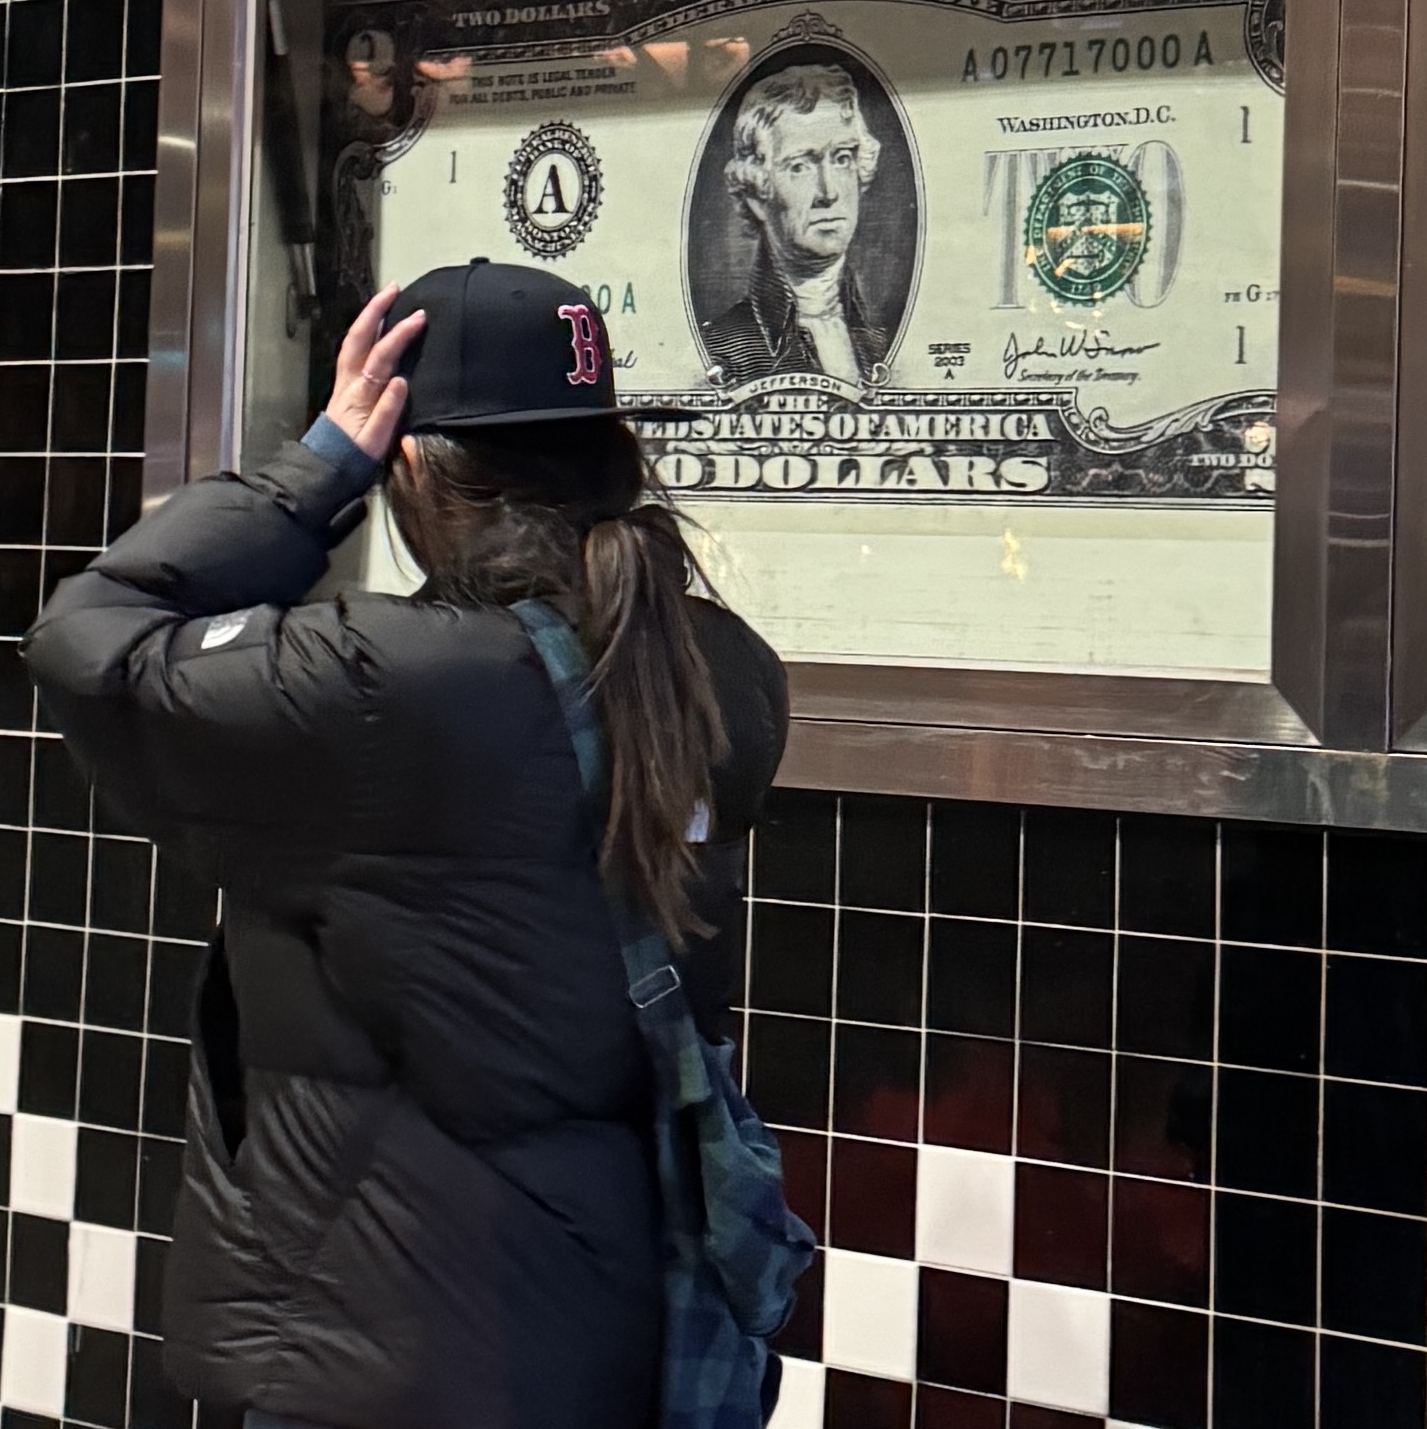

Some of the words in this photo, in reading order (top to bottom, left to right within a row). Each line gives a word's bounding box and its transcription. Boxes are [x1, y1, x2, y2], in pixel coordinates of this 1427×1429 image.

[452, 9, 501, 28] TWO
[503, 0, 611, 25] DOLLARS
[531, 163, 574, 215] A
[557, 304, 603, 386] B
[928, 342, 972, 355] SERIES
[934, 355, 966, 368] 2003
[748, 374, 841, 394] JEFFERSON
[944, 368, 955, 381] A
[763, 394, 828, 412] THE
[690, 413, 827, 440] STATES
[827, 413, 875, 440] OF
[870, 413, 1053, 440] AMERICA
[1190, 452, 1236, 467] TWO
[703, 454, 1050, 491] DOLLARS
